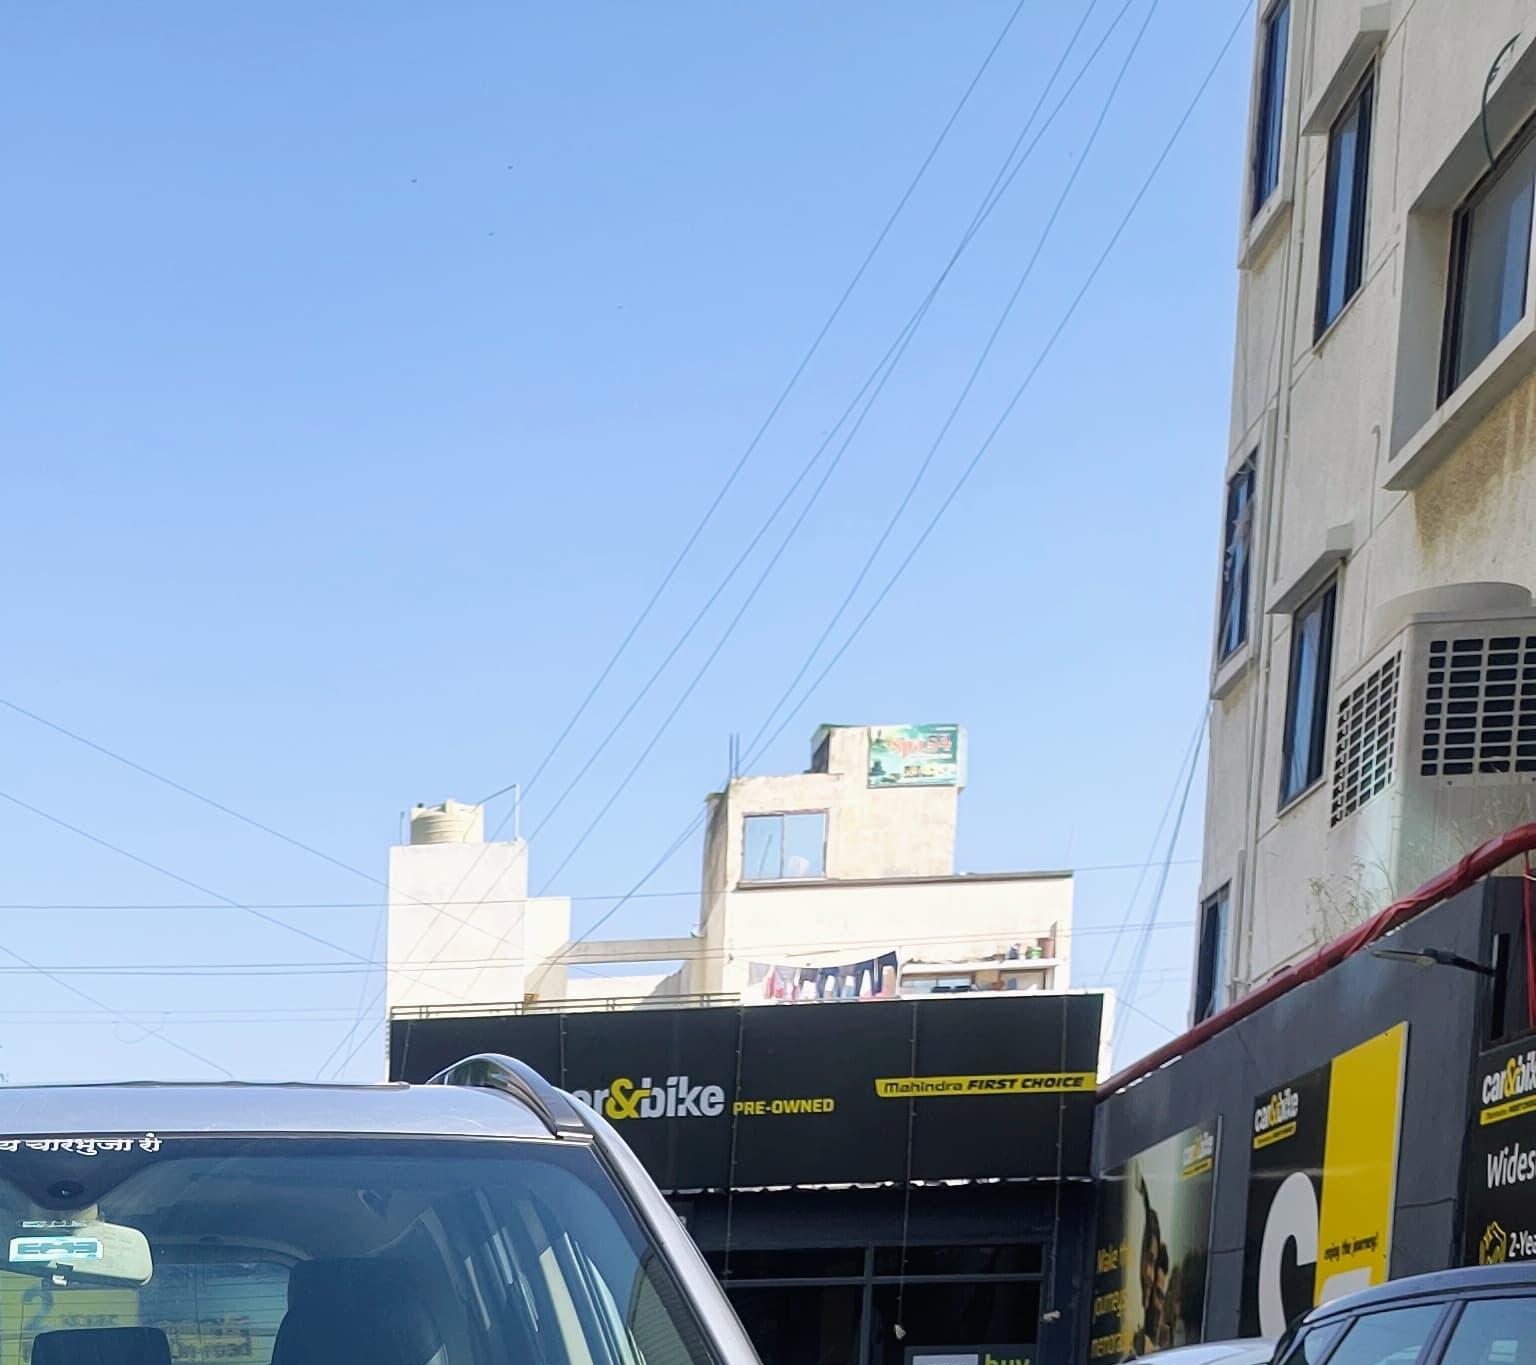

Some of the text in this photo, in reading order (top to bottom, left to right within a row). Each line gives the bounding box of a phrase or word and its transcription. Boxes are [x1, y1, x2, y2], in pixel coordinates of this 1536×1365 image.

[884, 1076, 1084, 1093] Mahindra FIRST CHOICE
[1482, 1050, 1536, 1105] car&bik
[571, 1076, 835, 1119] r&bike PRE-OWNED
[26, 1136, 134, 1156] चारभुजा
[1487, 1142, 1536, 1189] Wides
[1509, 1230, 1536, 1258] 2-Yea
